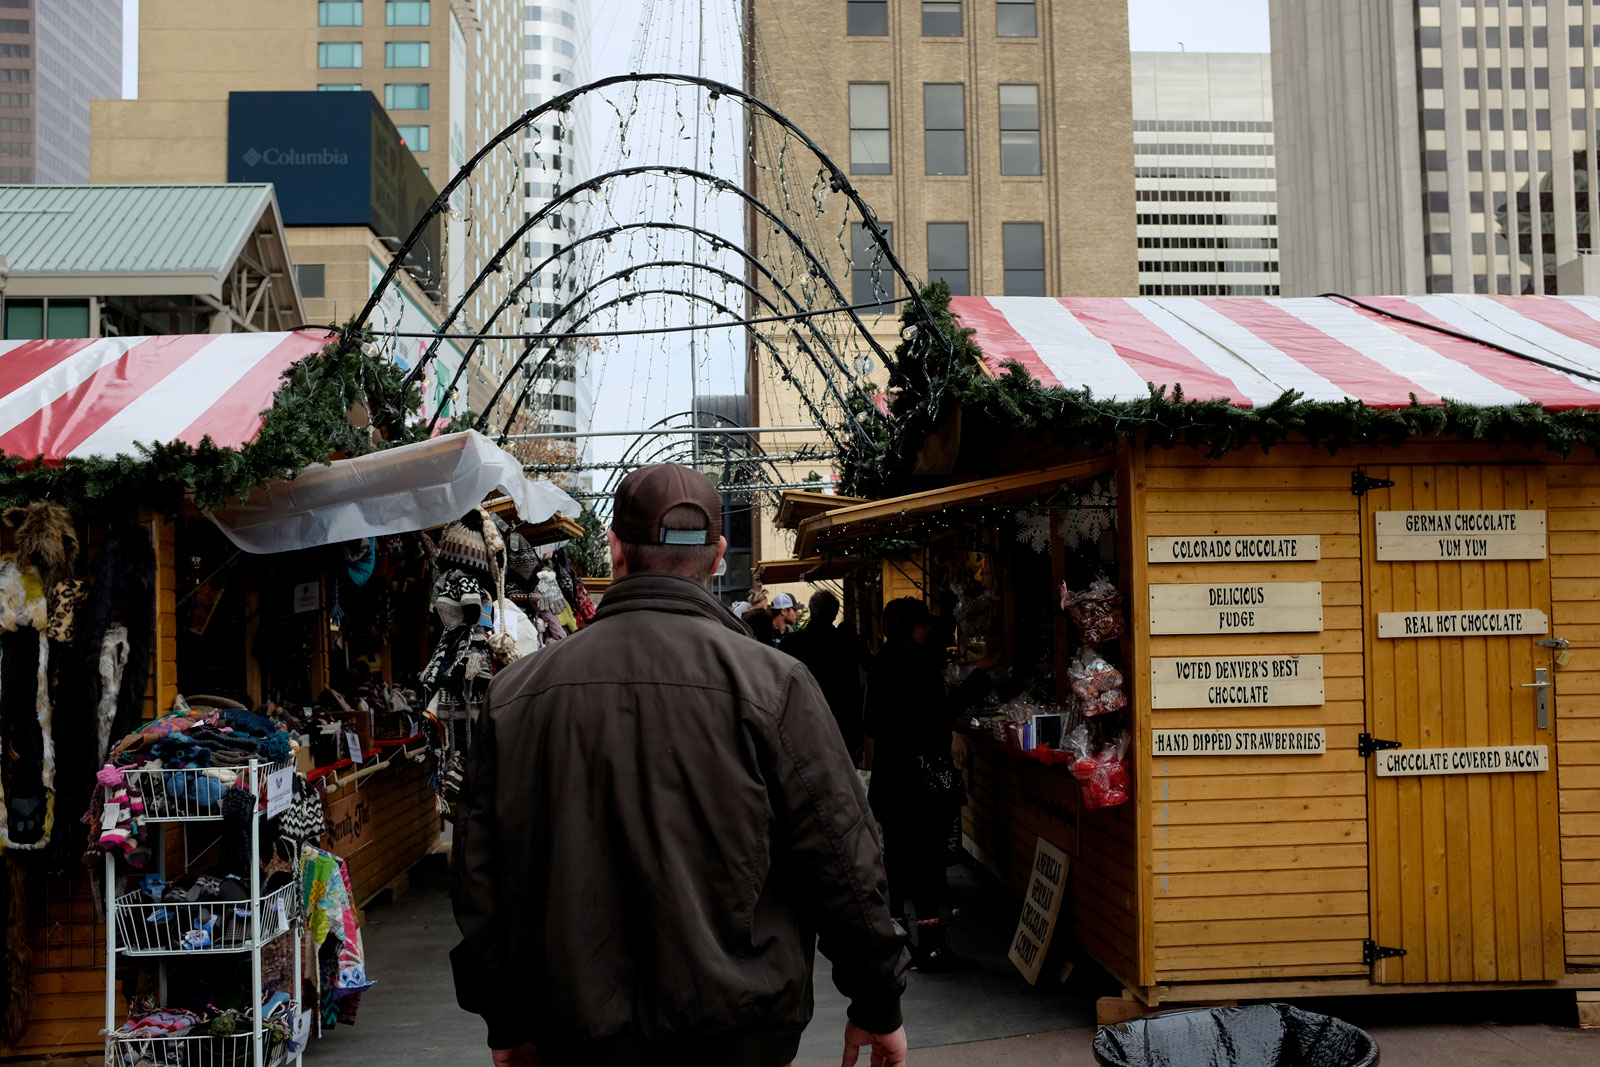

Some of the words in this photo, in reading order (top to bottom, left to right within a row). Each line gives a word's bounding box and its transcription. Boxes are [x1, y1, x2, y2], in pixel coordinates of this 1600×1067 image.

[263, 147, 348, 165] Columbia
[1405, 514, 1451, 532] GERMAN
[1455, 513, 1517, 531] CHOCOLATE
[1172, 540, 1231, 558] COLORADO
[1235, 539, 1297, 557] CHOCOLATE
[1438, 539, 1461, 557] YUM
[1465, 538, 1487, 556] YUM
[1209, 587, 1264, 606] DELICIOUS
[1219, 611, 1255, 630] FUDGE
[1404, 615, 1433, 634] REAL
[1436, 614, 1457, 633] HOT
[1460, 613, 1523, 632] CHOCOLATE
[1176, 661, 1211, 679] VOTED
[1216, 660, 1268, 679] DENVER'S
[1272, 659, 1299, 678] BEST
[1208, 685, 1268, 704] CHOCOLATE
[1157, 733, 1188, 751] HAND
[1192, 732, 1232, 750] DIPPED
[1235, 732, 1321, 750] STRAWBERRIES
[1387, 752, 1449, 772] CHOCOLATE
[1452, 751, 1501, 770] COVERED
[1505, 749, 1539, 768] BACON
[1021, 901, 1050, 944] CHOCOLATE
[1014, 930, 1040, 969] COMPANY
